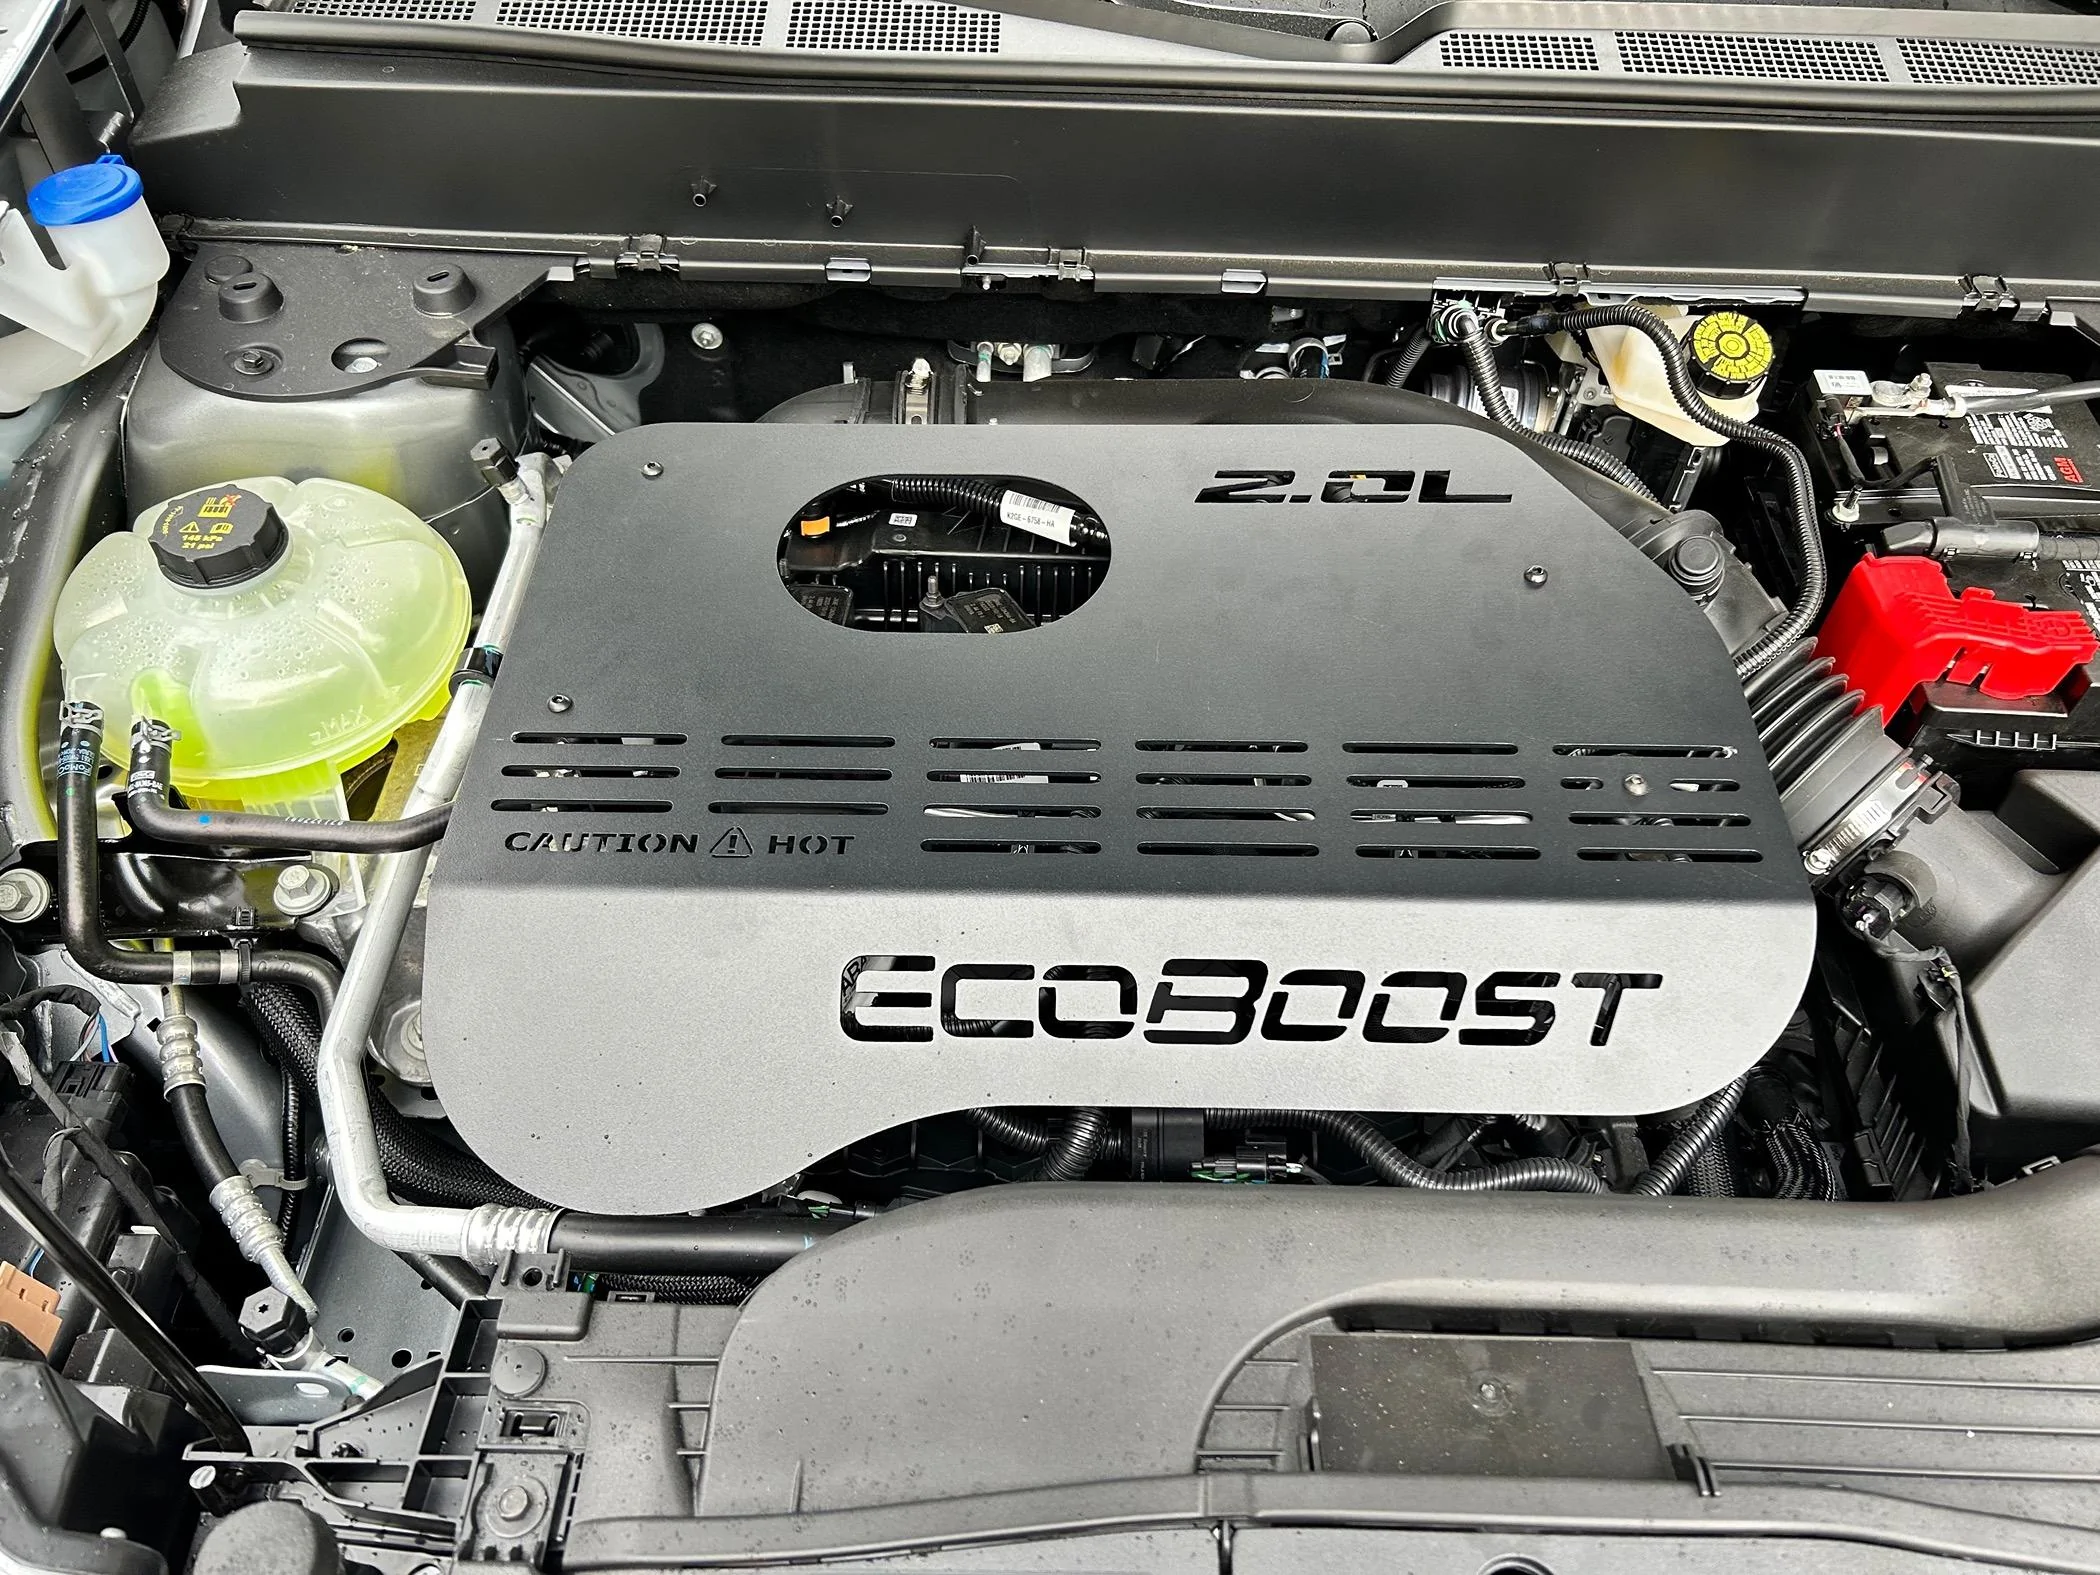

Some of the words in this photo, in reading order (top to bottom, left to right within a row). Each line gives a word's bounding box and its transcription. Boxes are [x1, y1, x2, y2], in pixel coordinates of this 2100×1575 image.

[2053, 456, 2078, 483] AGM
[1194, 470, 1513, 503] 2.0L
[202, 534, 223, 542] kPa
[504, 831, 699, 853] CAUTION
[768, 834, 856, 855] HOT
